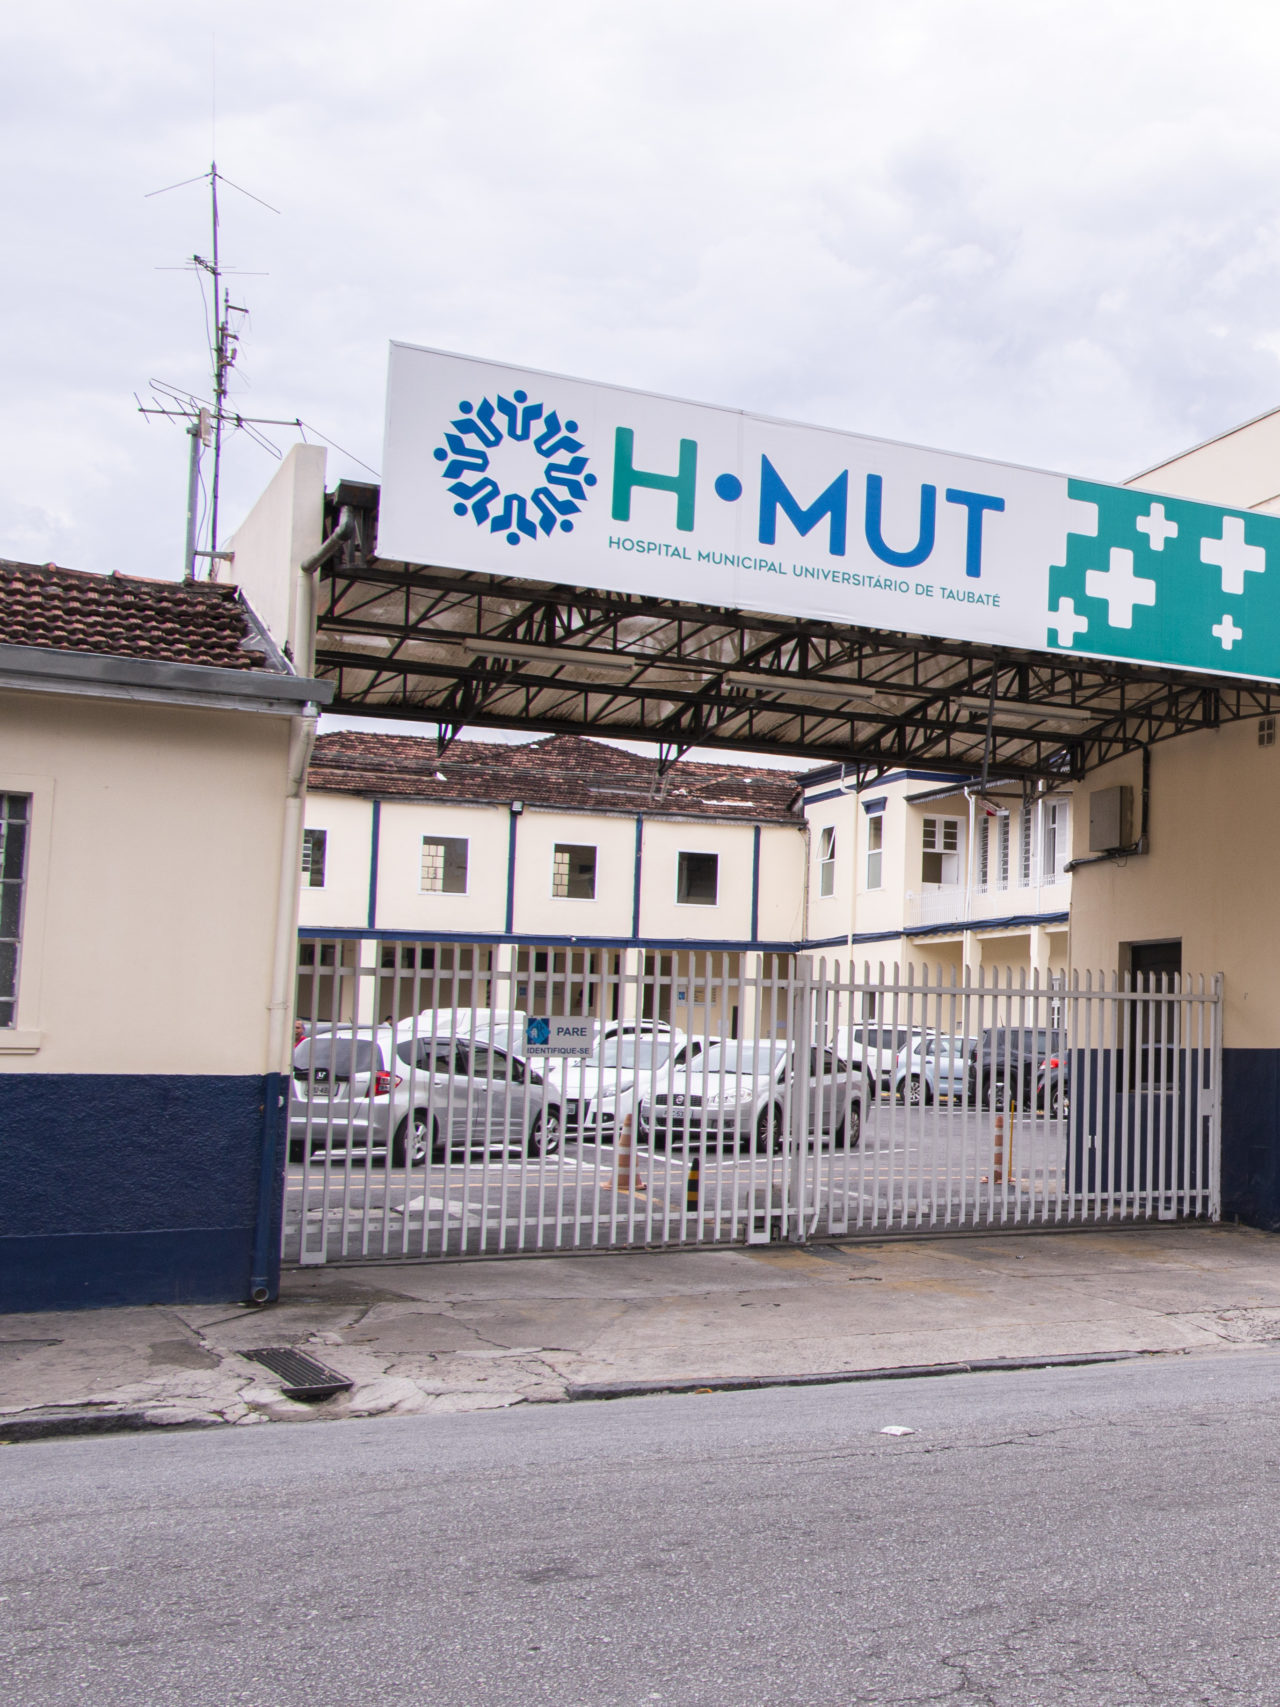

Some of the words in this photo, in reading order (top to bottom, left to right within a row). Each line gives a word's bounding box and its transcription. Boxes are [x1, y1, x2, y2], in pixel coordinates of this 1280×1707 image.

[608, 535, 692, 561] HOSPITAL
[697, 549, 788, 576] MUNICIPAL
[792, 563, 910, 594] UNIVERSITÁRIO
[914, 583, 934, 597] DE
[939, 586, 1000, 608] TAUBATÉ
[556, 1027, 588, 1037] PARE
[526, 1047, 590, 1055] IDENTIFIQUE-SE
